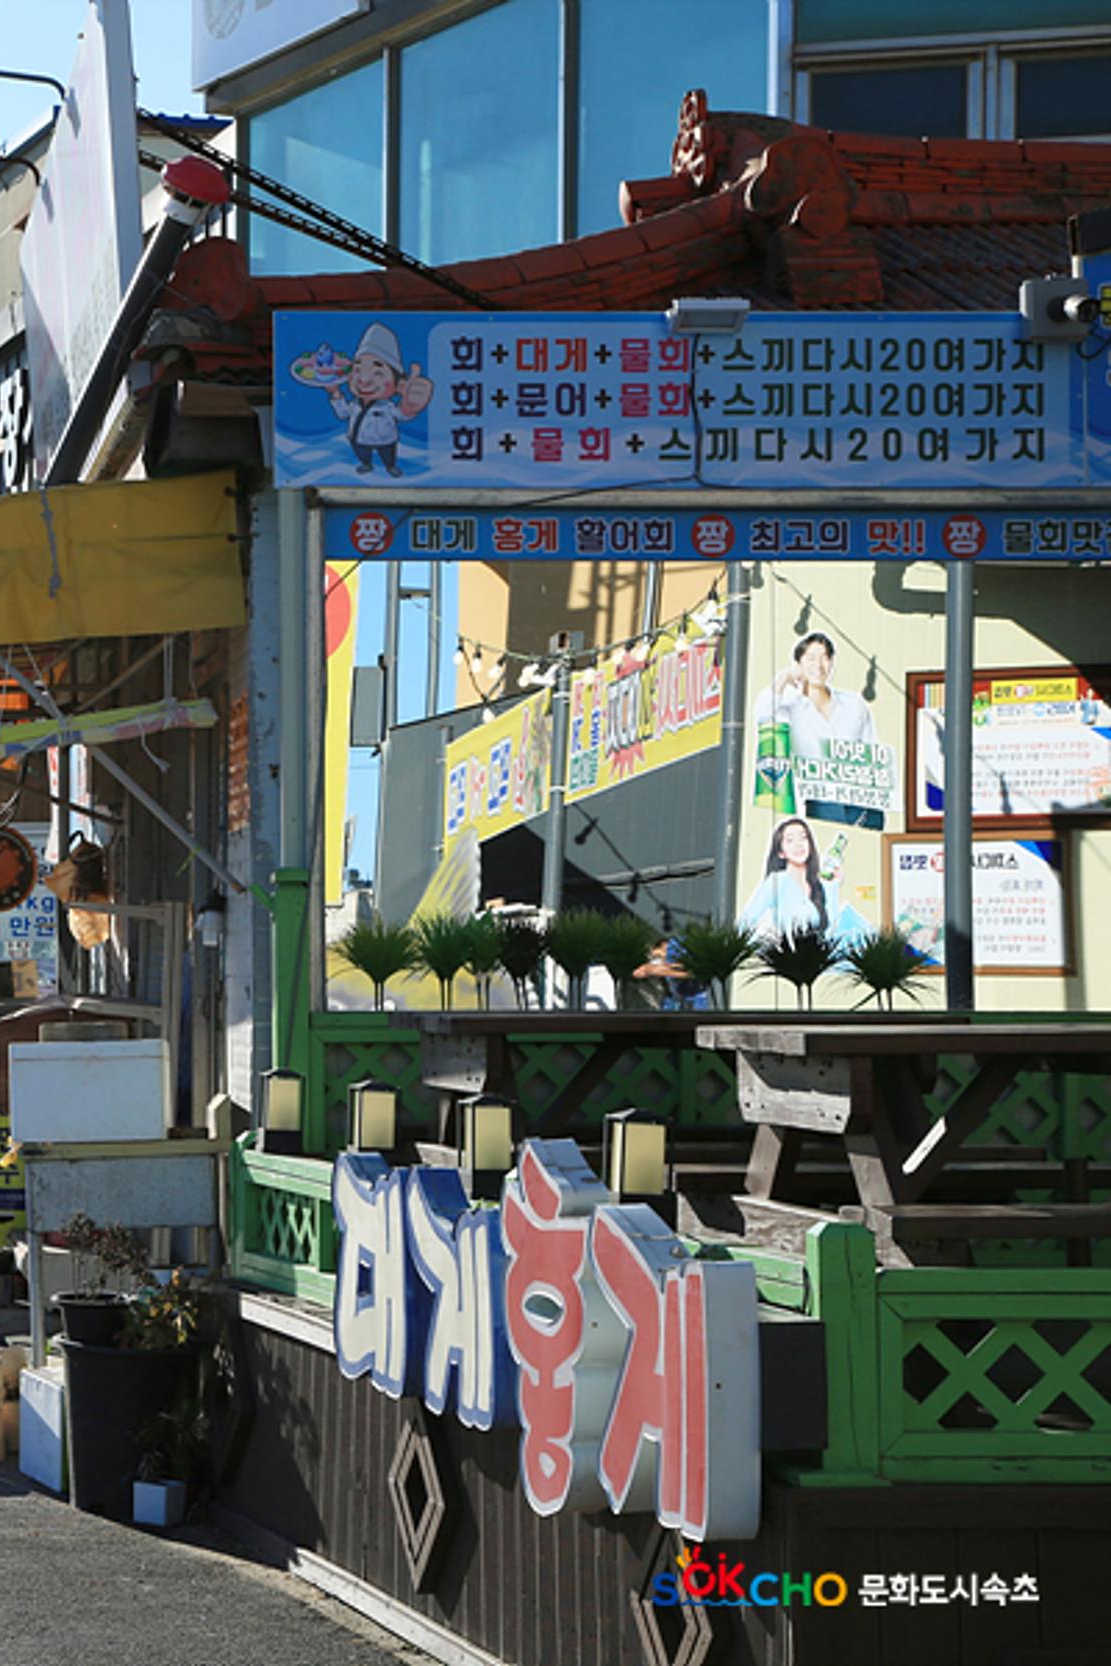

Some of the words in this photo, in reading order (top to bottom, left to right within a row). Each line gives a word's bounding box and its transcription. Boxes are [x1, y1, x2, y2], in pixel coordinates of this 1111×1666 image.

[412, 518, 476, 552] 대게
[493, 518, 558, 552] 홍게
[576, 518, 674, 552] 활어회
[696, 519, 733, 553] 짱
[750, 519, 850, 553] 최고의
[867, 519, 925, 553] 맛!!
[948, 519, 983, 553] 짱
[1003, 518, 1111, 554] 물회맛
